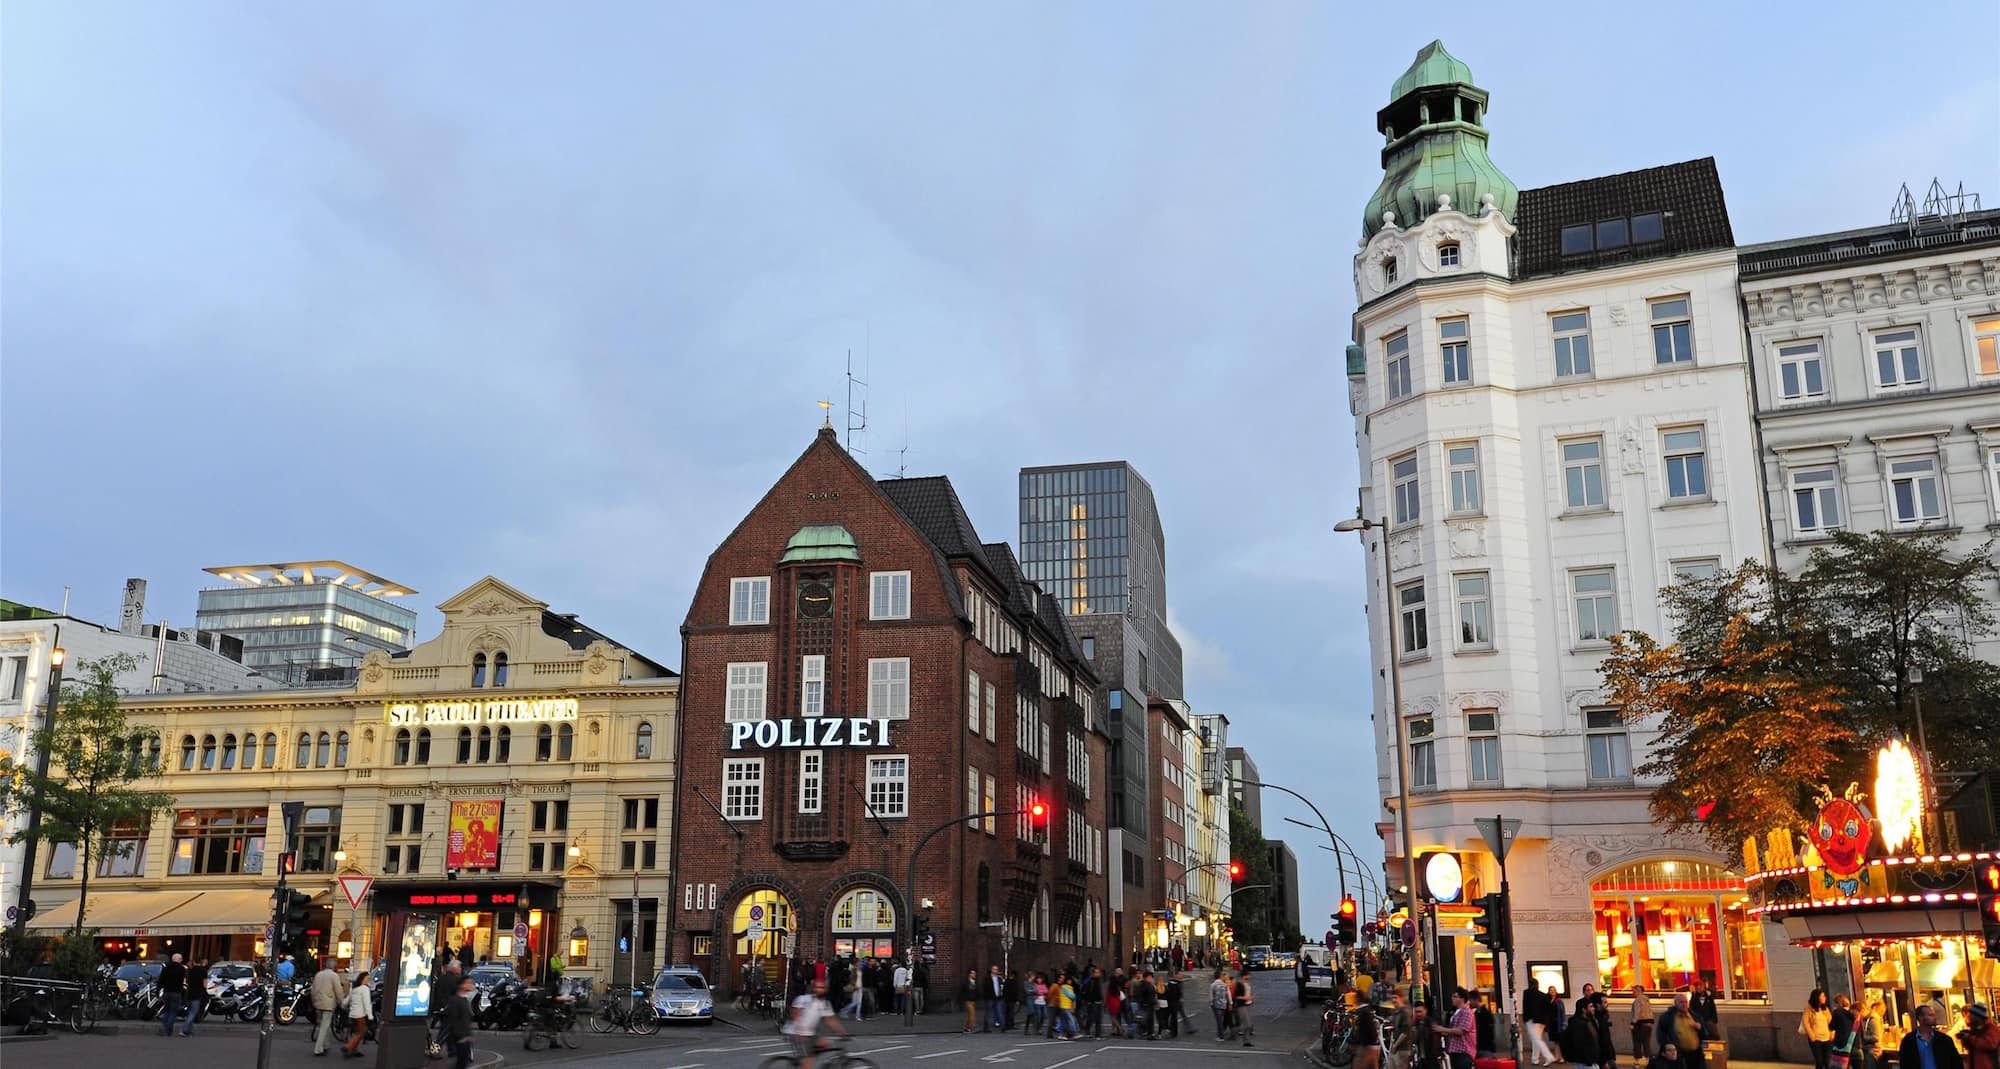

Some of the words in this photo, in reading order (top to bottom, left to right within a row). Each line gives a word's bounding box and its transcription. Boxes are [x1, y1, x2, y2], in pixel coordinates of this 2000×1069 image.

[390, 704, 420, 726] ST.
[423, 701, 482, 725] PAULI
[485, 699, 579, 723] THEATER
[731, 717, 890, 750] POLIZEI
[389, 788, 423, 798] EHEMALS
[449, 787, 472, 797] ERNST
[472, 785, 506, 796] DRUCKER
[532, 785, 566, 795] THEATER
[455, 804, 467, 817] The
[469, 803, 481, 817] 27
